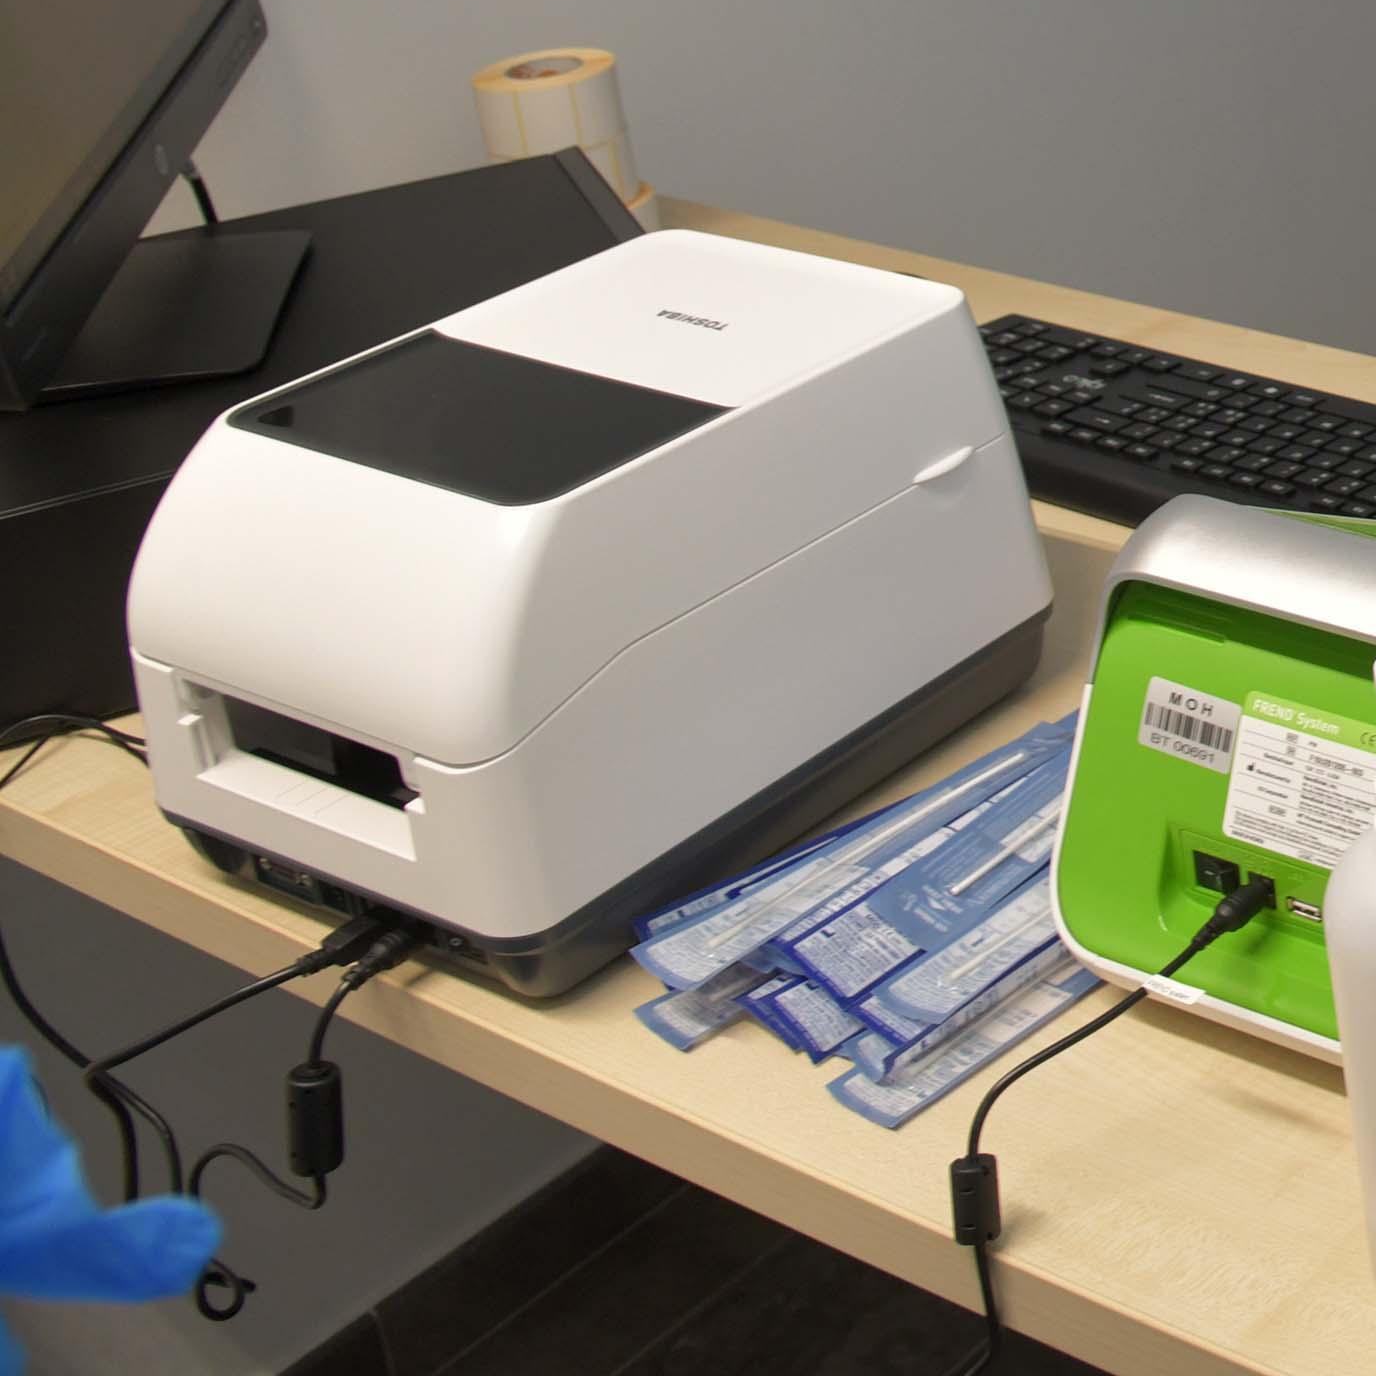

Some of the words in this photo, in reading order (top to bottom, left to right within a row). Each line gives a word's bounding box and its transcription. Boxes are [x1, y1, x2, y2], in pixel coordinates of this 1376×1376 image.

[656, 310, 728, 331] TOSHIBA
[1296, 712, 1340, 735] System
[1150, 732, 1171, 747] BT
